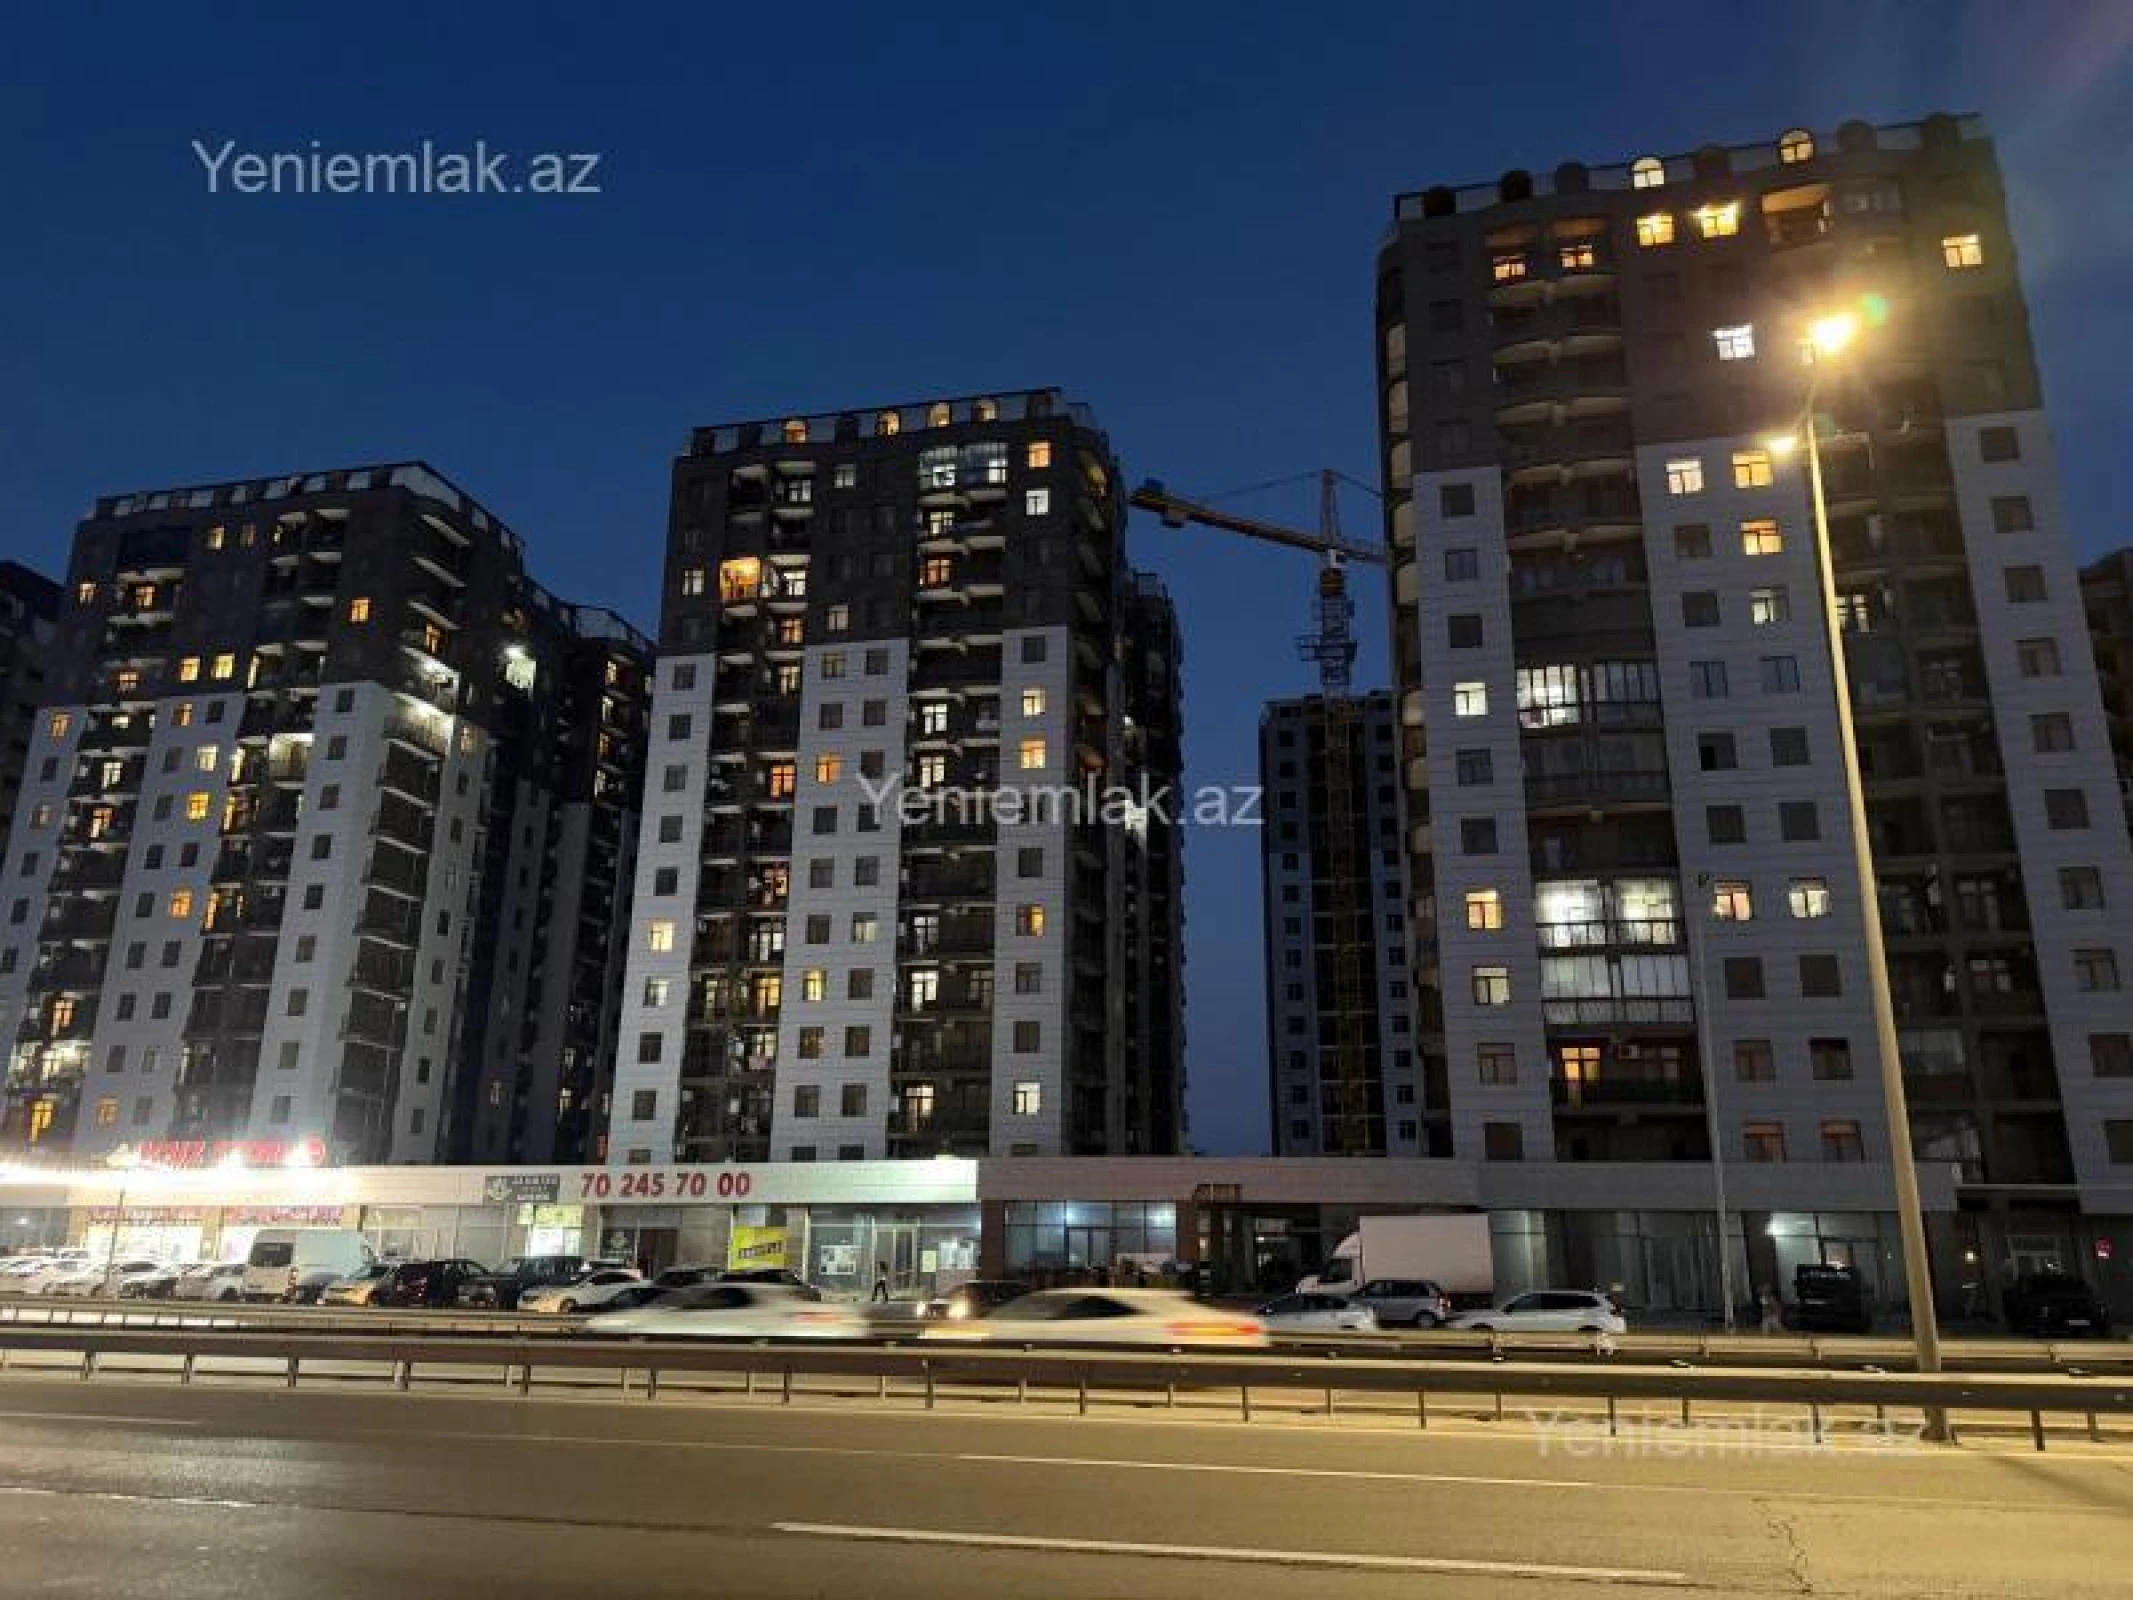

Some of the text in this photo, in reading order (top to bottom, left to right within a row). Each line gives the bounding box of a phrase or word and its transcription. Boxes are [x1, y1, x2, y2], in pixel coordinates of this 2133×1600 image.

[581, 1173, 611, 1197] 70
[619, 1173, 665, 1197] 245
[676, 1173, 707, 1196] 70
[717, 1172, 751, 1196] 00
